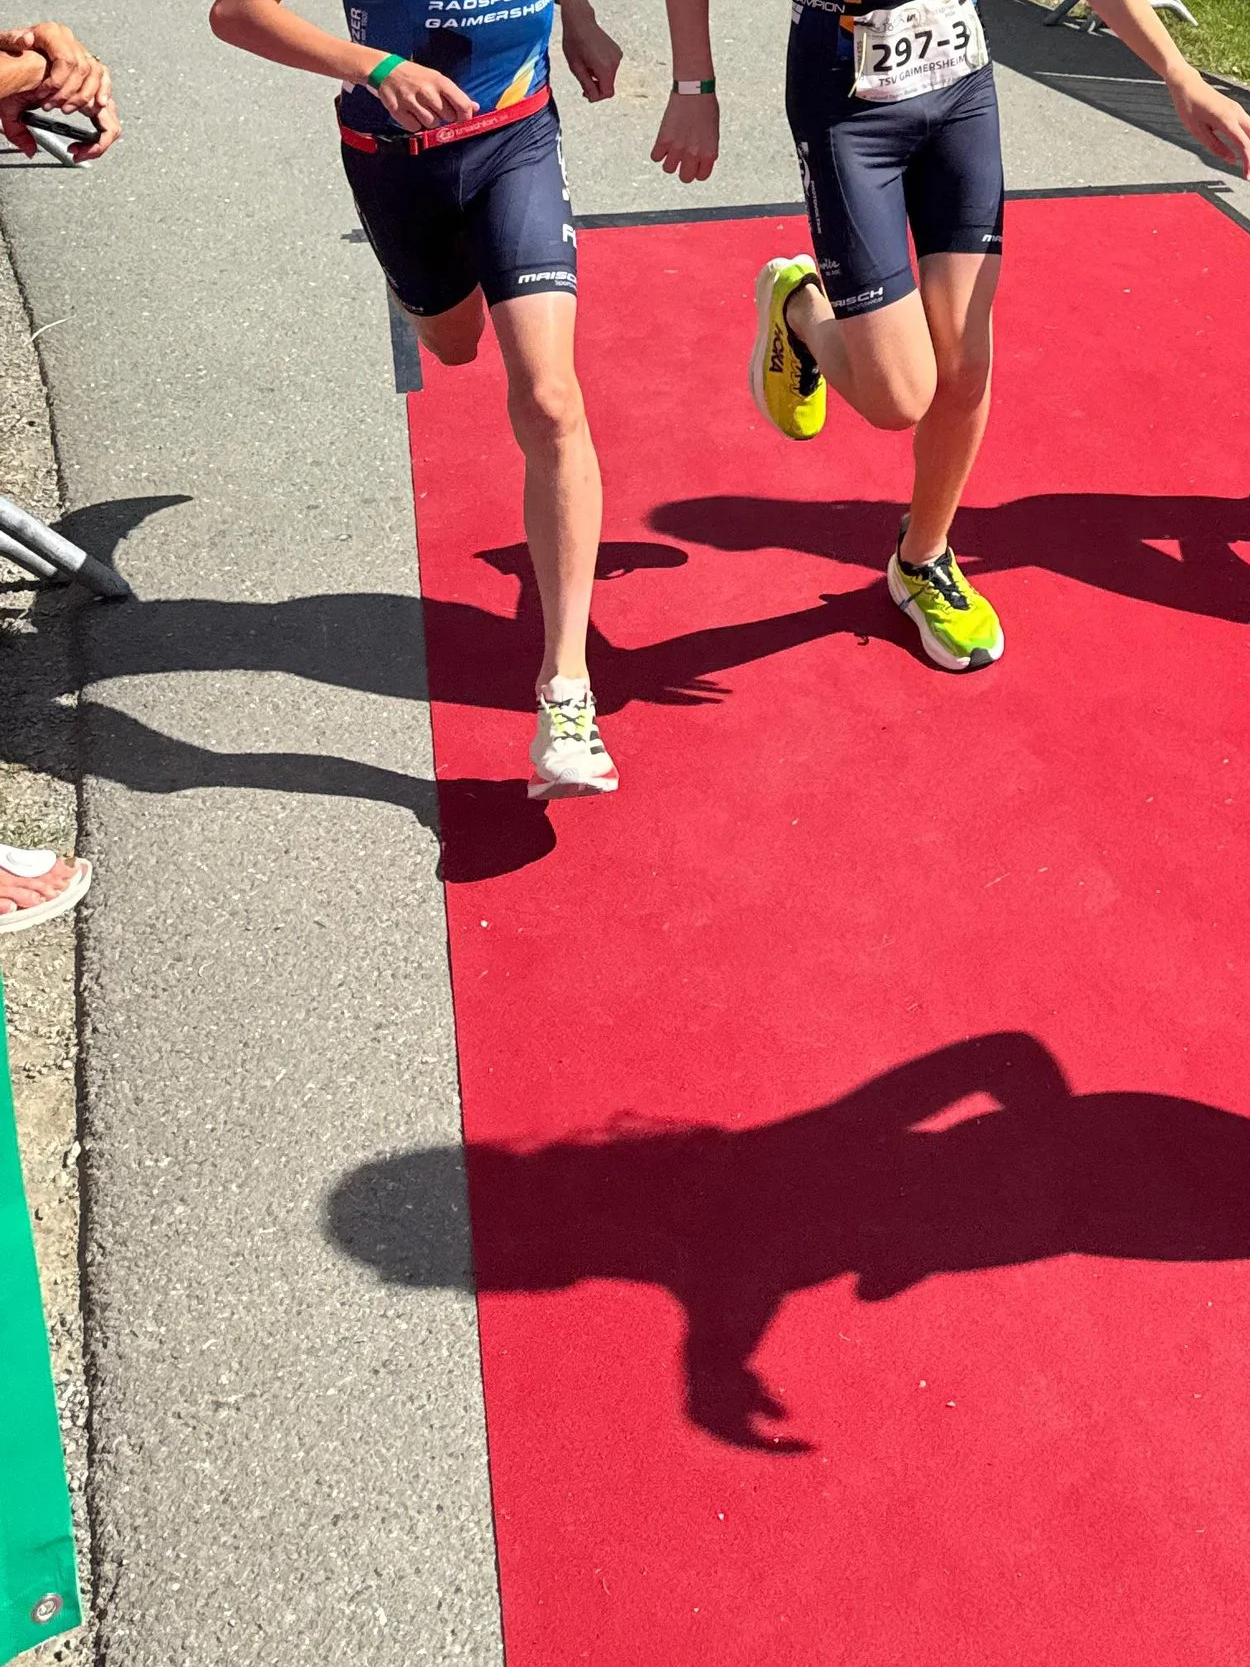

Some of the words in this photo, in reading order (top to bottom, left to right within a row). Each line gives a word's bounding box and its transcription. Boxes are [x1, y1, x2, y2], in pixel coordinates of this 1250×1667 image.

[871, 20, 970, 73] 297-3
[878, 76, 898, 88] TSV
[899, 54, 967, 82] GAIMERSHEIM
[518, 270, 577, 284] MAISC
